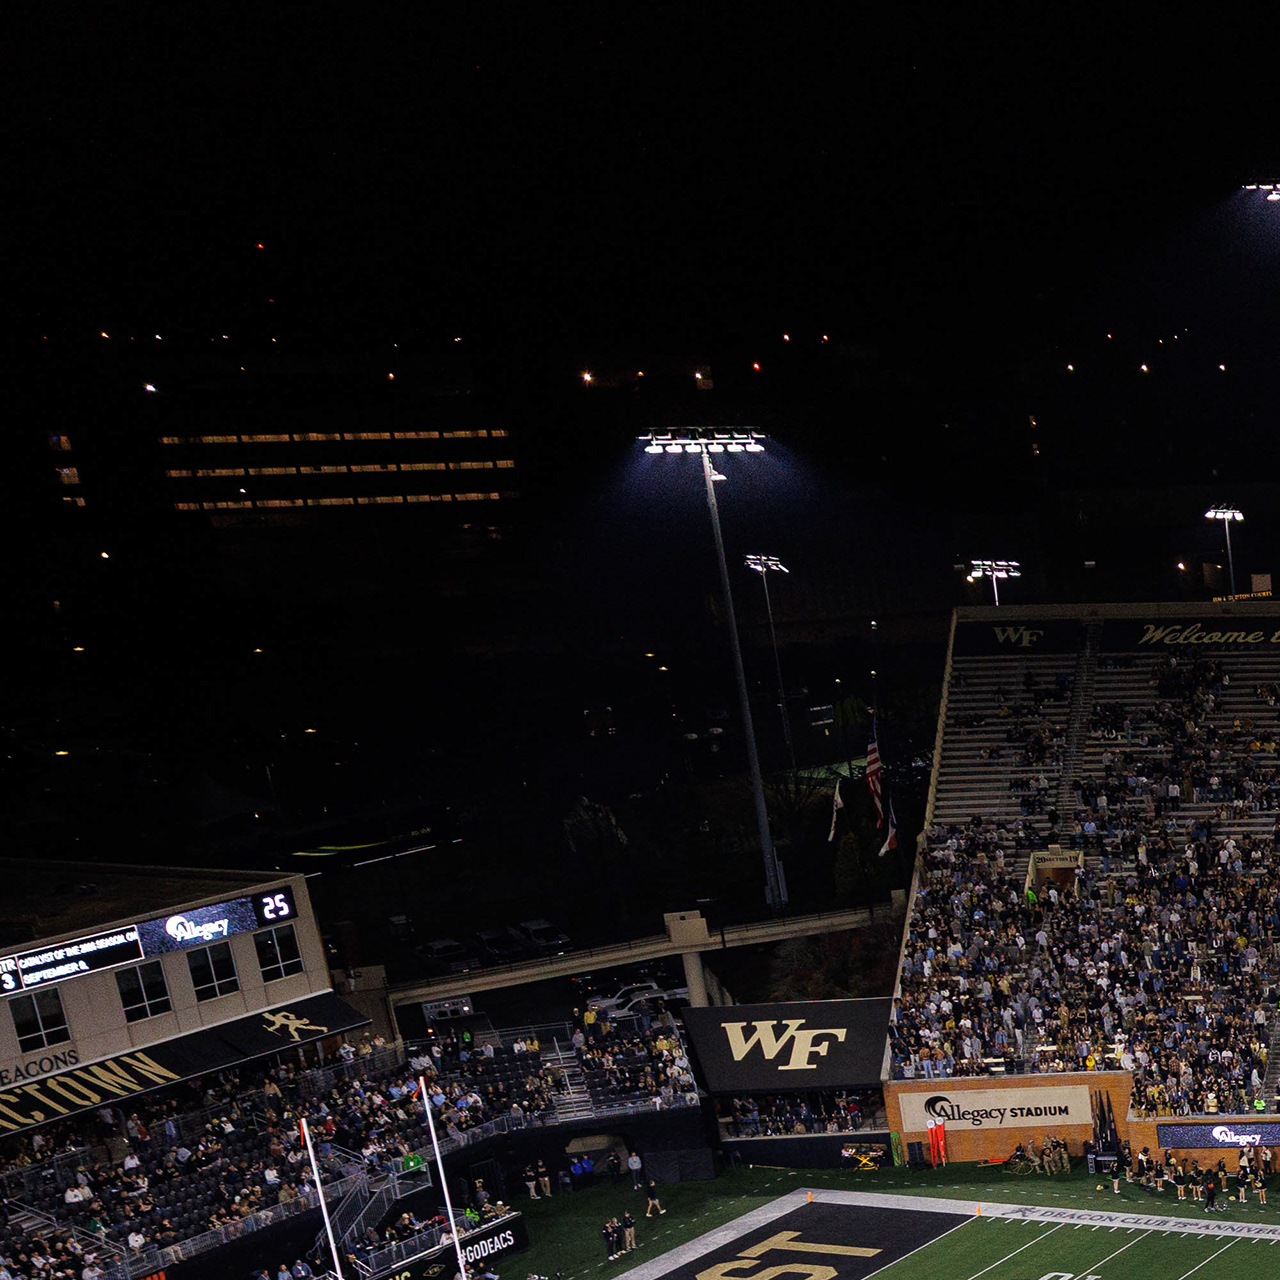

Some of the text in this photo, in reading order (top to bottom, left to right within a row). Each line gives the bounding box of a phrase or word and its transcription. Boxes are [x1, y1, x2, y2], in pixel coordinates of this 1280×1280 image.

[1137, 623, 1265, 645] Welcome
[263, 893, 289, 919] 25
[174, 917, 229, 942] Allegacy
[2, 973, 15, 989] 3
[23, 963, 79, 985] SEPTEMBER
[721, 1018, 847, 1070] WF
[934, 1101, 1069, 1127] Allegacy STADIUM
[1216, 1129, 1262, 1147] Allegacy
[1038, 1210, 1120, 1223] DEACON
[1120, 1216, 1170, 1227] CLUB
